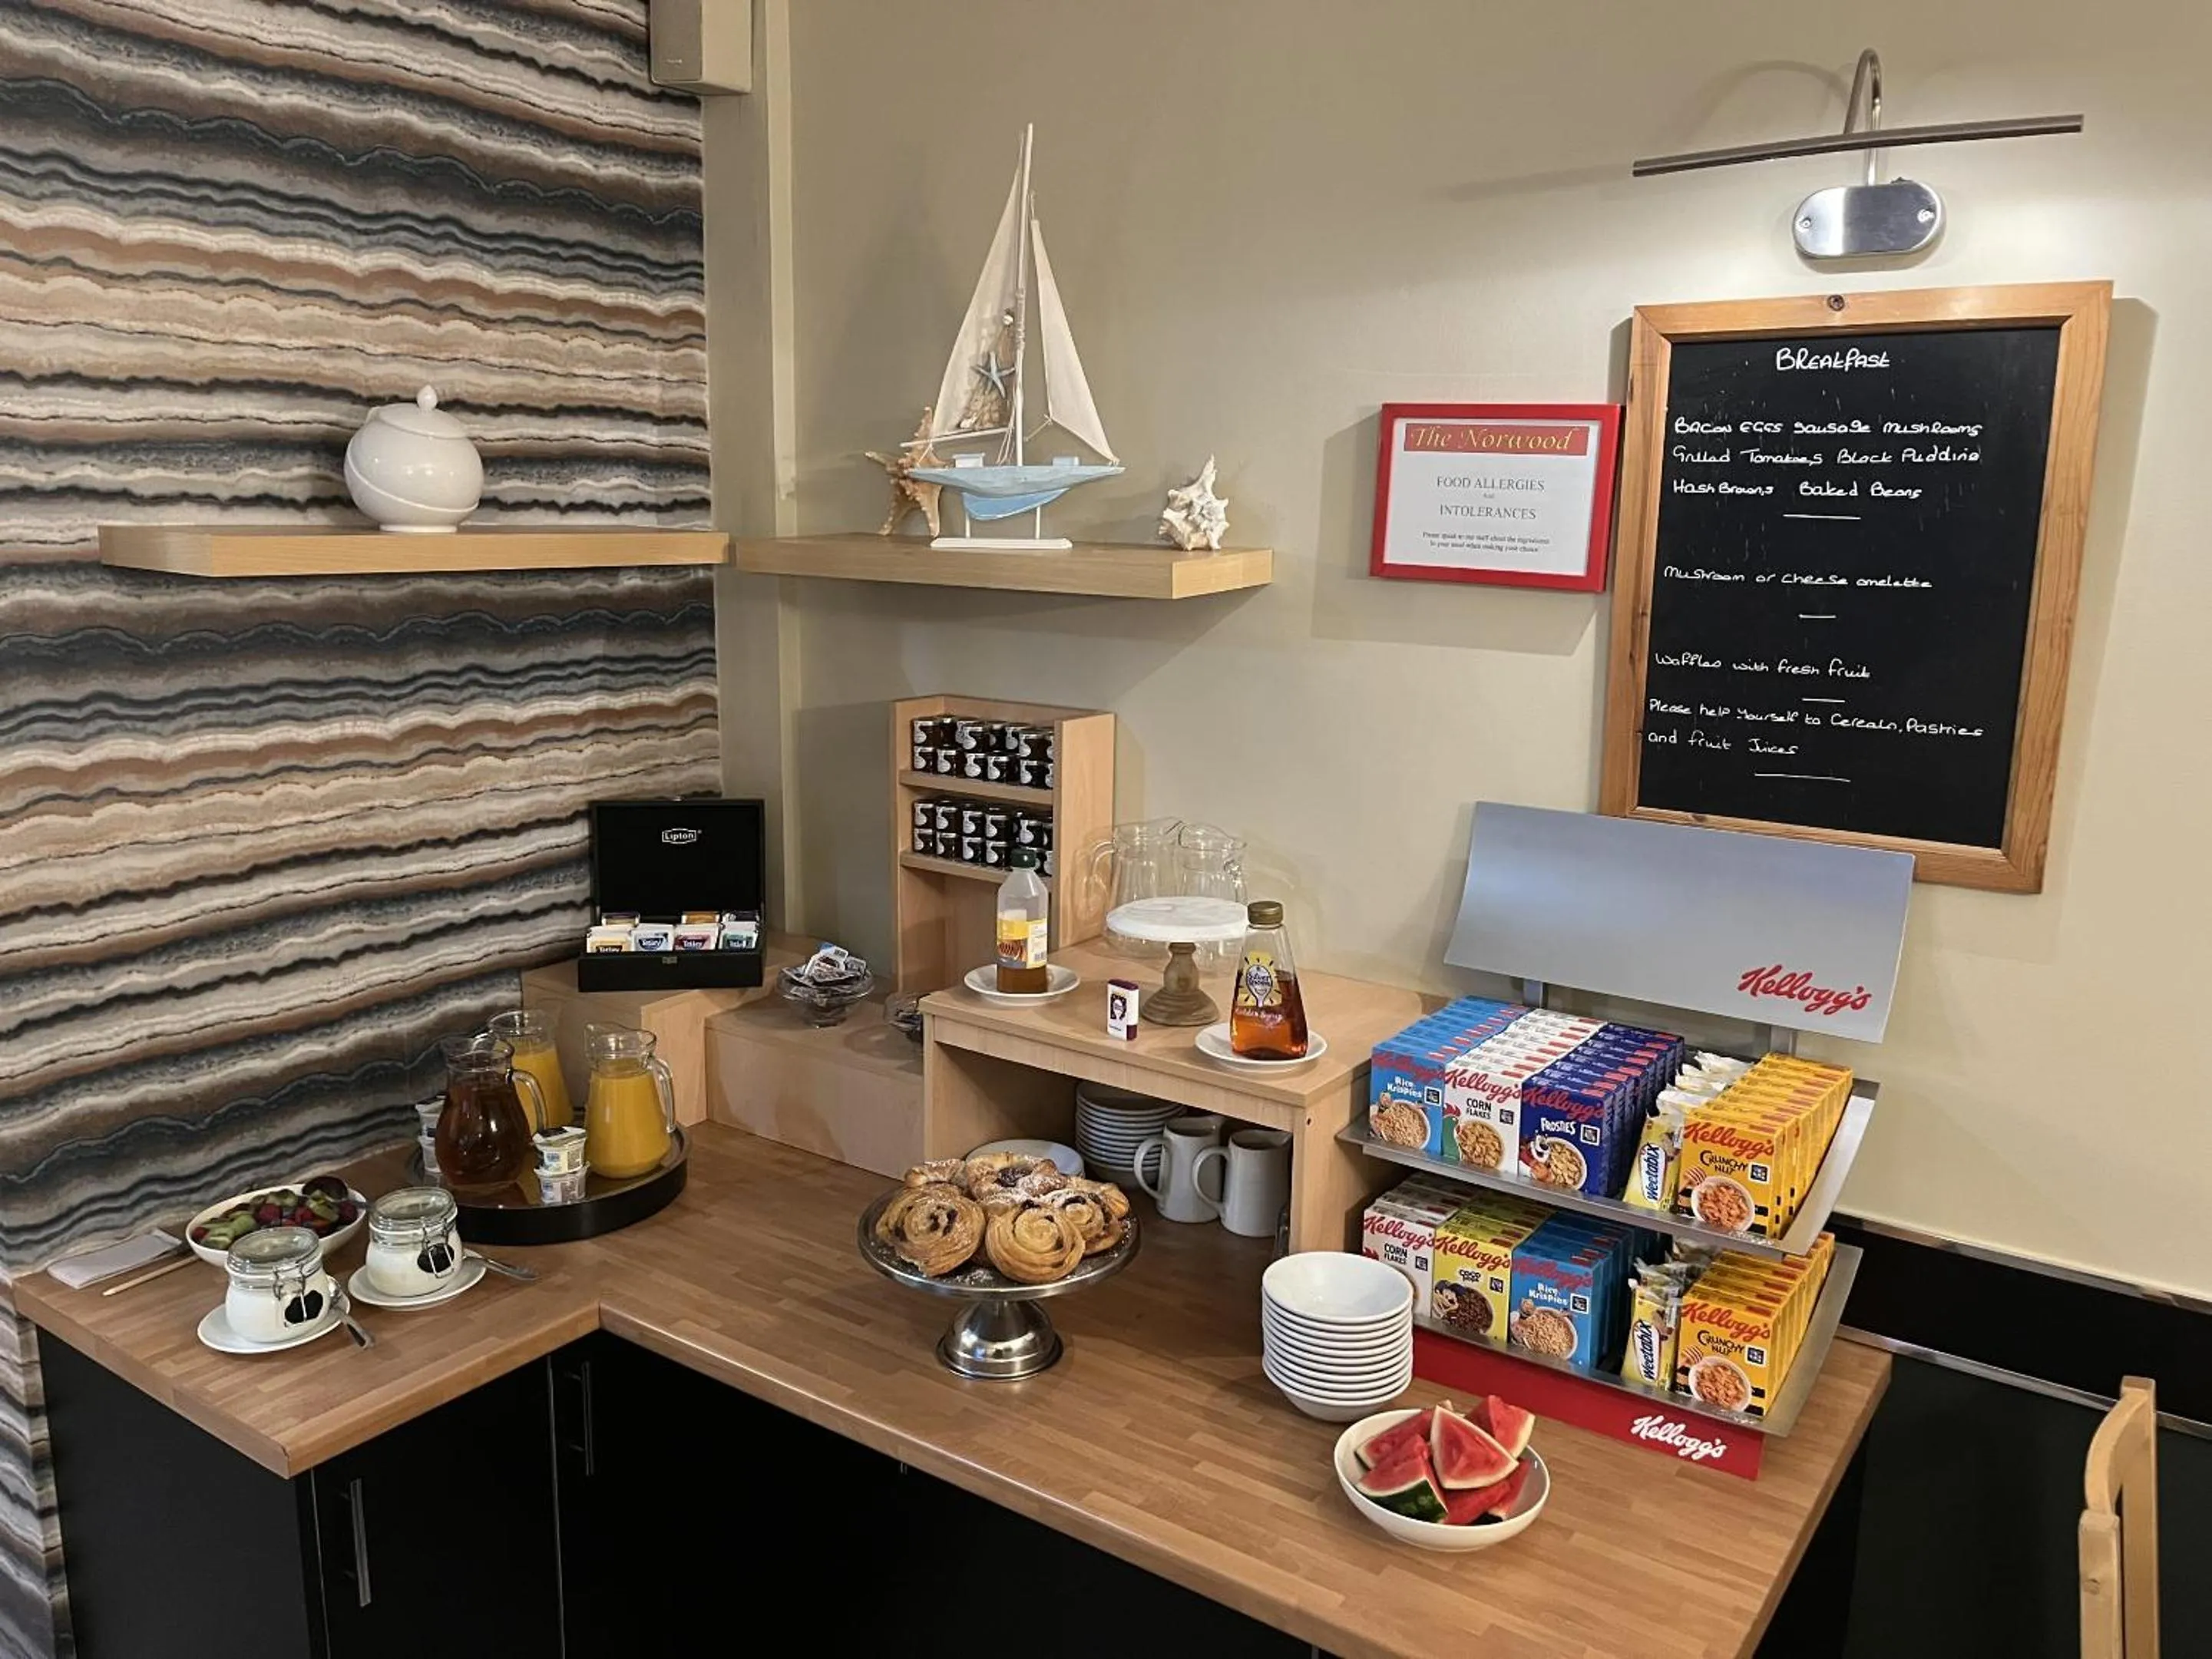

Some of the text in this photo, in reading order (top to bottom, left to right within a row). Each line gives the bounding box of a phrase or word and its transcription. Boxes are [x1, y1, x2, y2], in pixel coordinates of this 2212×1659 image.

[1410, 425, 1579, 451] The Norwood
[1437, 476, 1545, 491] FOOD ALLERGIES
[1439, 504, 1537, 521] INTOLERANCES
[1804, 713, 1821, 725] to
[664, 831, 694, 841] Lipton
[1736, 964, 1872, 1015] Kellogg's
[1387, 1082, 1423, 1099] Krispies
[1394, 1076, 1415, 1089] Rice
[1443, 1068, 1522, 1105] Kellogg's
[1466, 1097, 1492, 1112] CORN
[1466, 1107, 1492, 1120] FLAKES
[1521, 1086, 1607, 1121] Kellogg's
[1683, 1122, 1774, 1160] Kellogg's
[1699, 1149, 1748, 1172] CRUNCHY
[1714, 1164, 1736, 1176] NUT
[1643, 1142, 1661, 1202] Weetabix
[1364, 1215, 1437, 1248] Kellogg's
[1383, 1252, 1408, 1267] FLAKES
[1384, 1241, 1409, 1258] CORN
[1435, 1233, 1511, 1271] Kellogg's
[1529, 1288, 1569, 1306] Krispies
[1537, 1282, 1559, 1295] Rice
[1681, 1302, 1771, 1342] Kellogg's
[1637, 1319, 1655, 1380] Weetabix
[1697, 1330, 1746, 1353] CRUNCHY
[1630, 1415, 1727, 1459] Kellogg's
